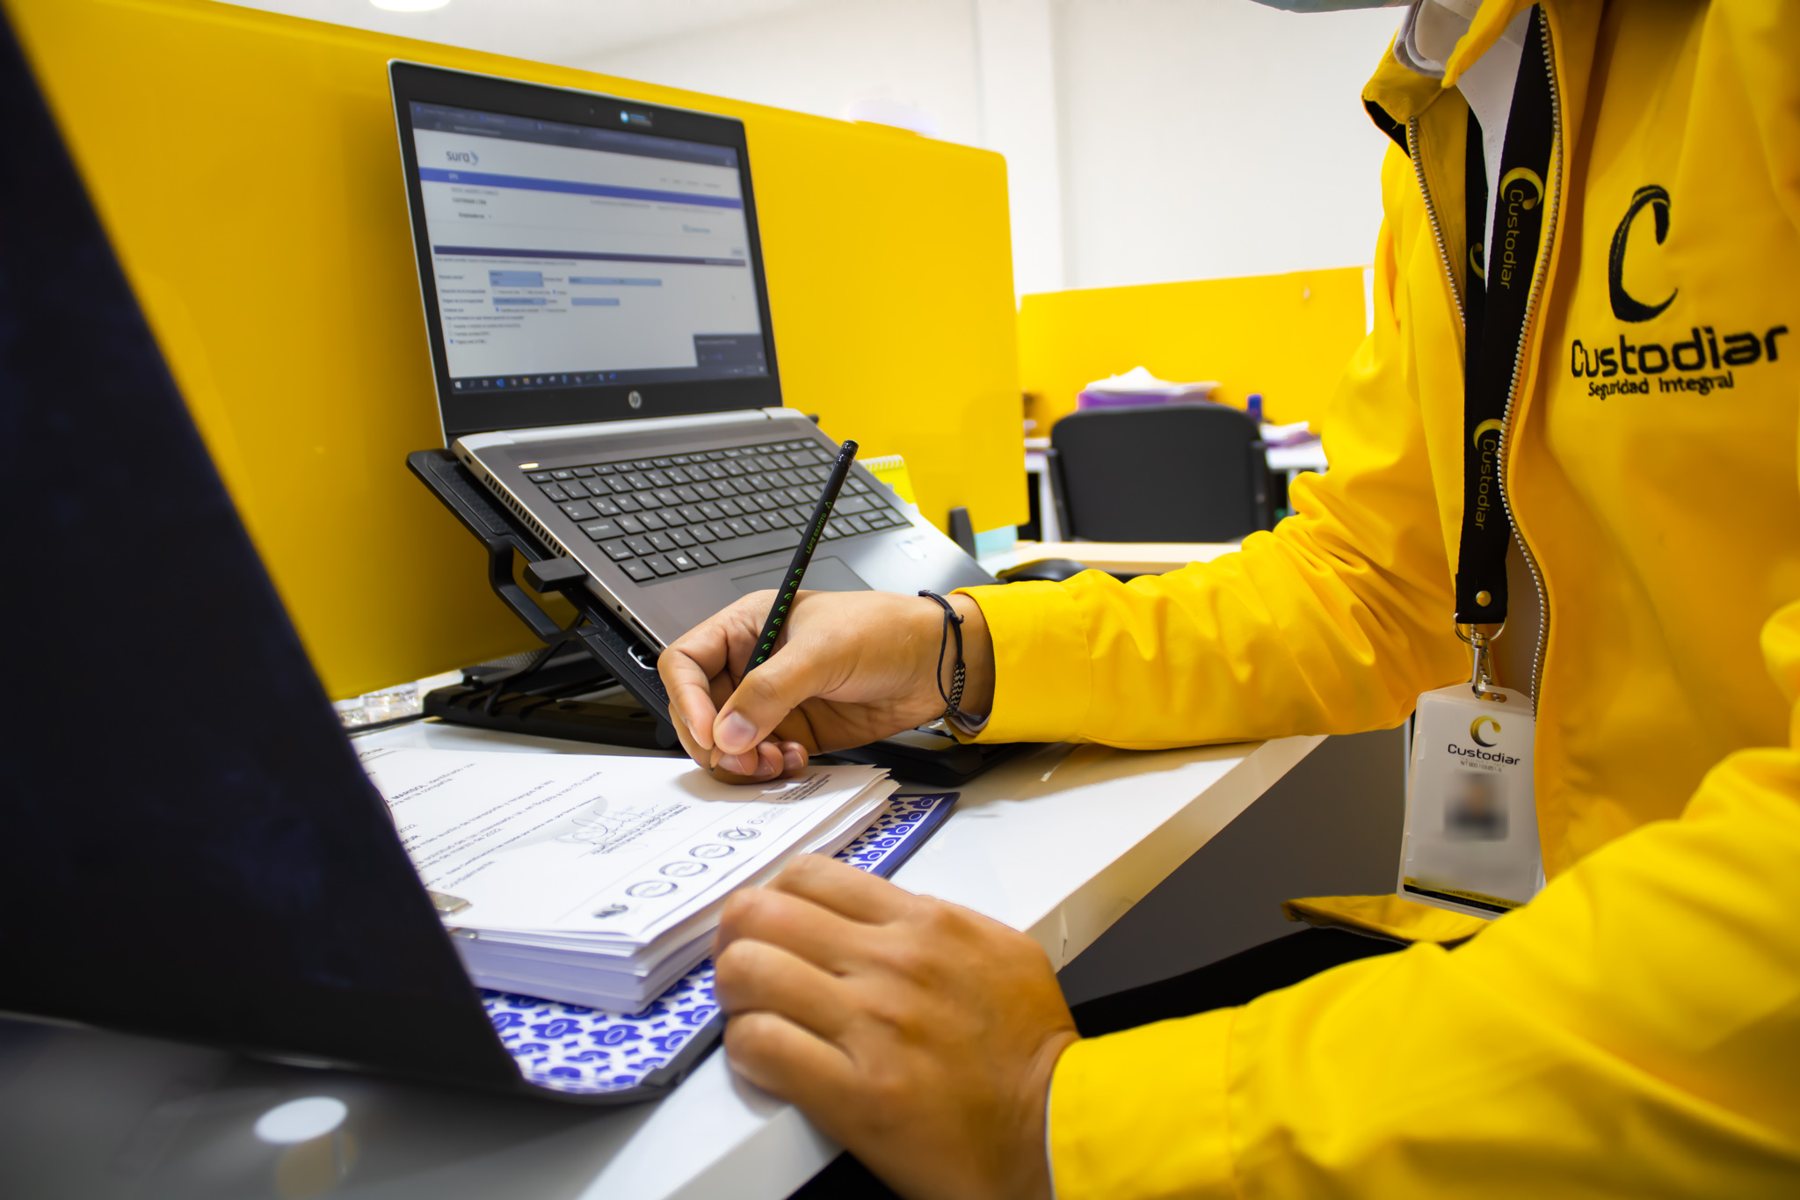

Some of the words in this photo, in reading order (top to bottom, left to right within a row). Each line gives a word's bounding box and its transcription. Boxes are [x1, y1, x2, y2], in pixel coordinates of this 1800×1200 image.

[1501, 189, 1524, 290] Custodiar
[1571, 325, 1789, 378] Custodiar
[1588, 378, 1650, 401] Seguridad
[1659, 370, 1734, 396] Integral
[1475, 438, 1497, 531] Custodiar
[1447, 743, 1520, 765] Custodiar
